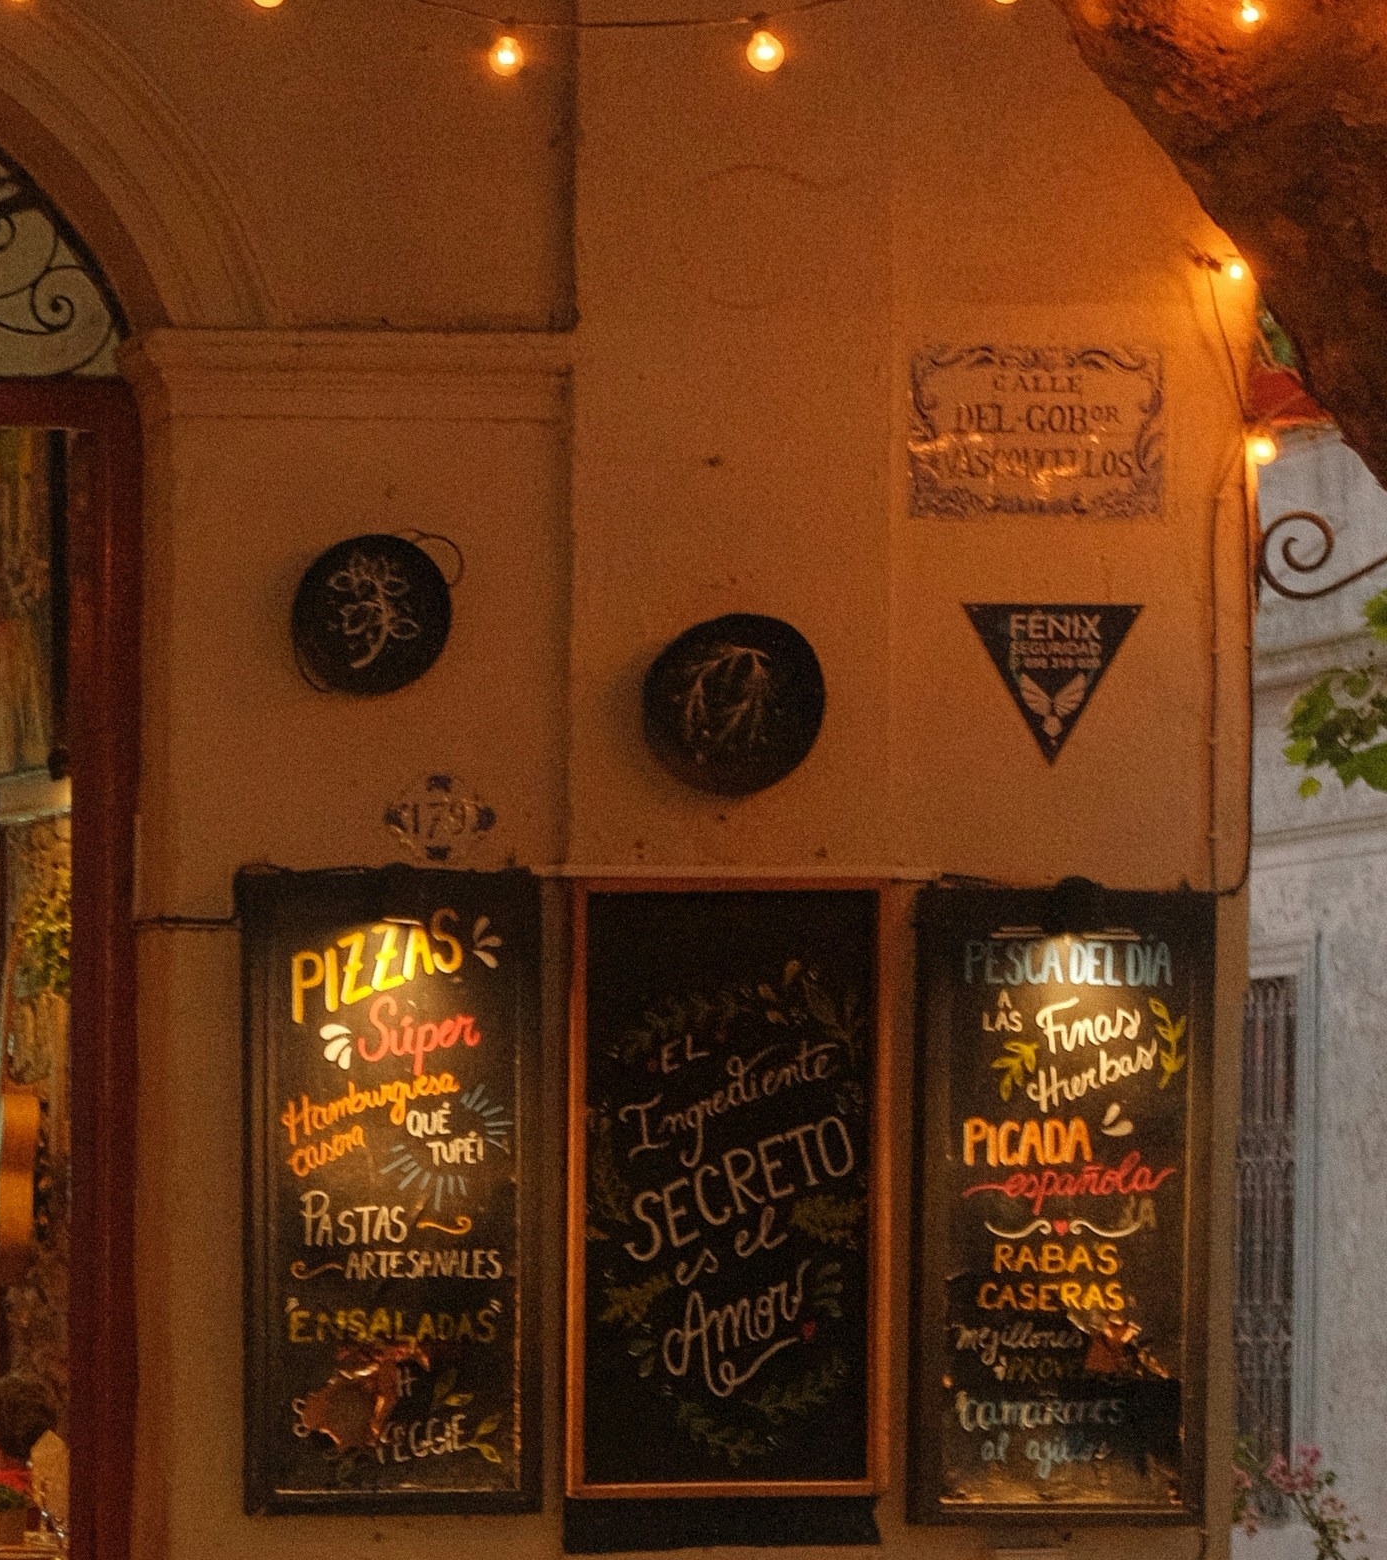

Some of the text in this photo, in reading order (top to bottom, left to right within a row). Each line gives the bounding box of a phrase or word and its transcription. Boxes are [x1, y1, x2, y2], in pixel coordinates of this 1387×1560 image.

[993, 374, 1083, 393] CALLE
[291, 907, 463, 1024] PIZZAS
[964, 939, 1064, 986] PESCA
[1069, 941, 1122, 986] DEL
[982, 1010, 1023, 1032] LAS
[997, 989, 1013, 1009] A
[1035, 996, 1142, 1055] Finas
[660, 1034, 710, 1073] EL
[1026, 1037, 1158, 1113] Hierbas
[281, 1072, 460, 1145] Hamburguesa
[618, 1039, 840, 1168] Ingrediente
[963, 1116, 1093, 1167] PICADA
[624, 1116, 854, 1261] SECRETO
[962, 1150, 1176, 1215] española
[299, 1190, 408, 1246] PASTAS
[676, 1205, 788, 1286] es el
[344, 1249, 504, 1280] ARTESANALES
[993, 1242, 1121, 1275] RABAS
[978, 1281, 1126, 1311] CASERAS
[662, 1258, 813, 1397] Amor
